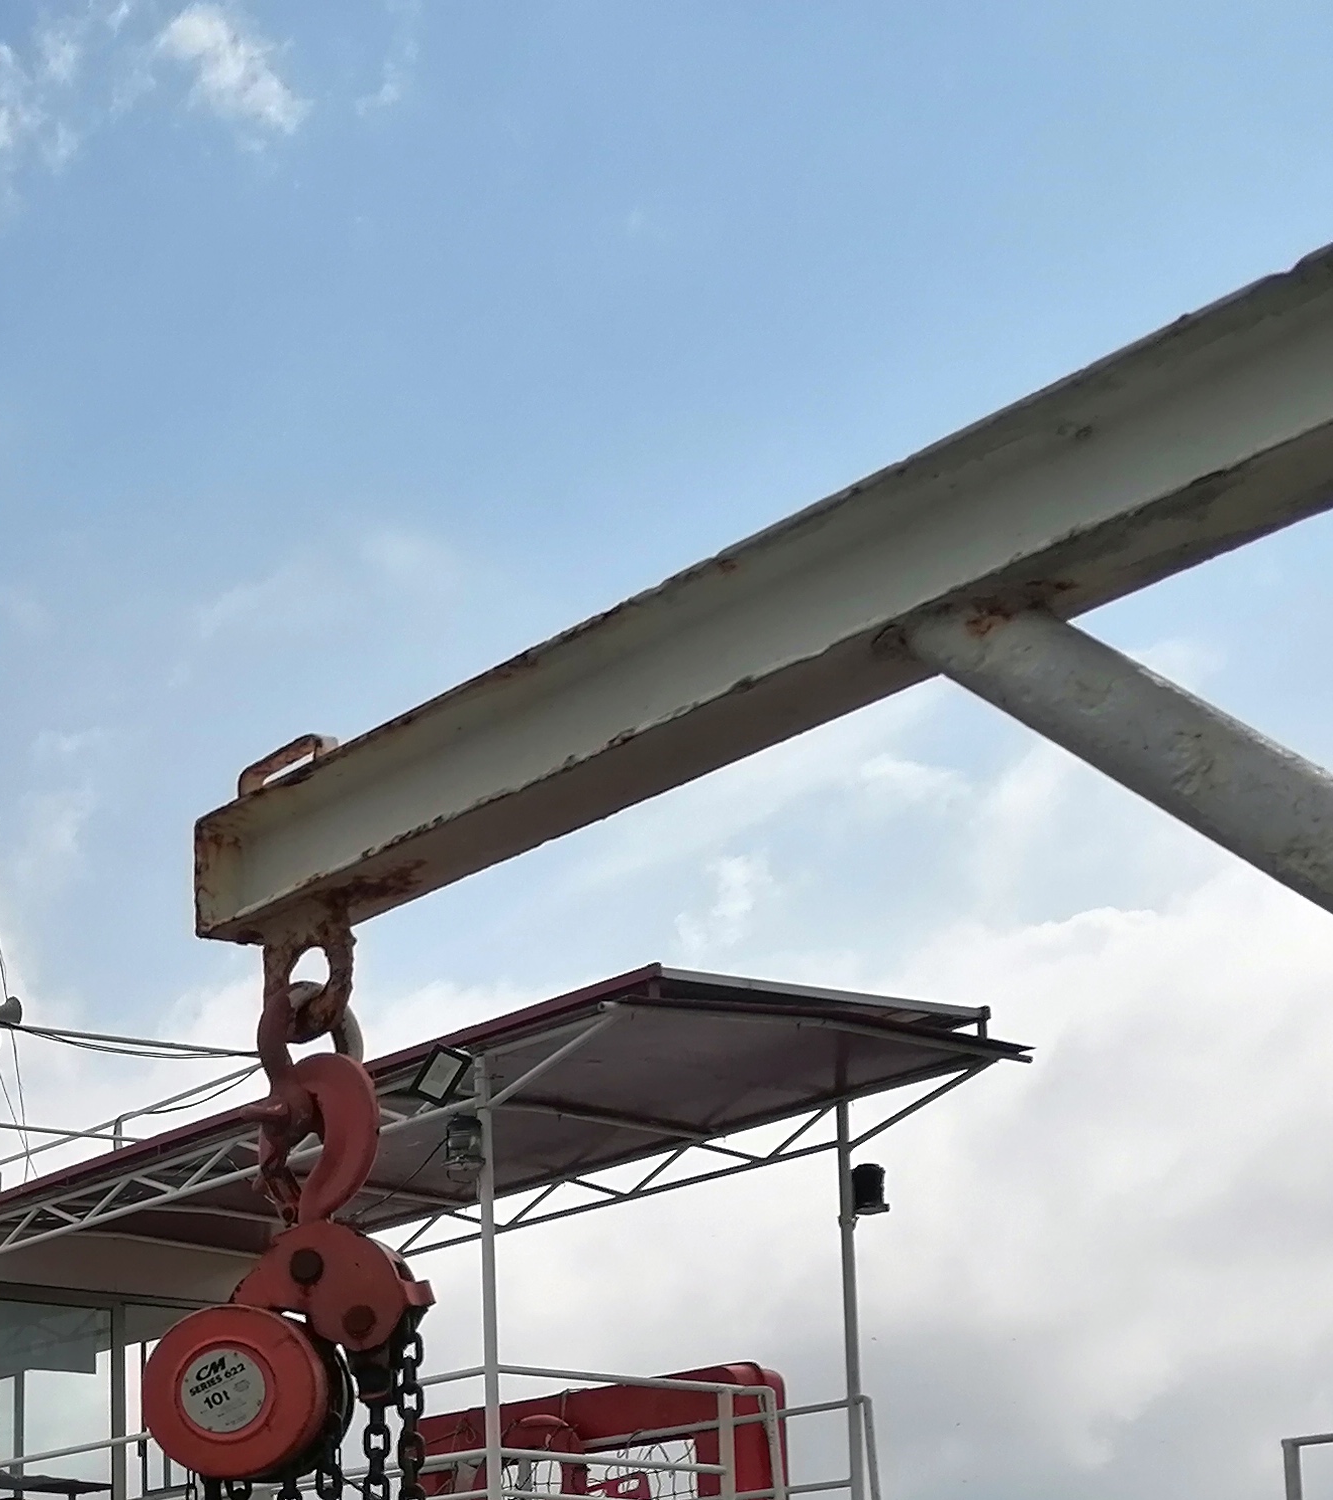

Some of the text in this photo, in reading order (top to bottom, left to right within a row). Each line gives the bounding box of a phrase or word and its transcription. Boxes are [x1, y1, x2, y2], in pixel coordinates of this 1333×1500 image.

[190, 1375, 223, 1397] SERIES
[224, 1363, 246, 1379] 622
[196, 1356, 226, 1381] CM
